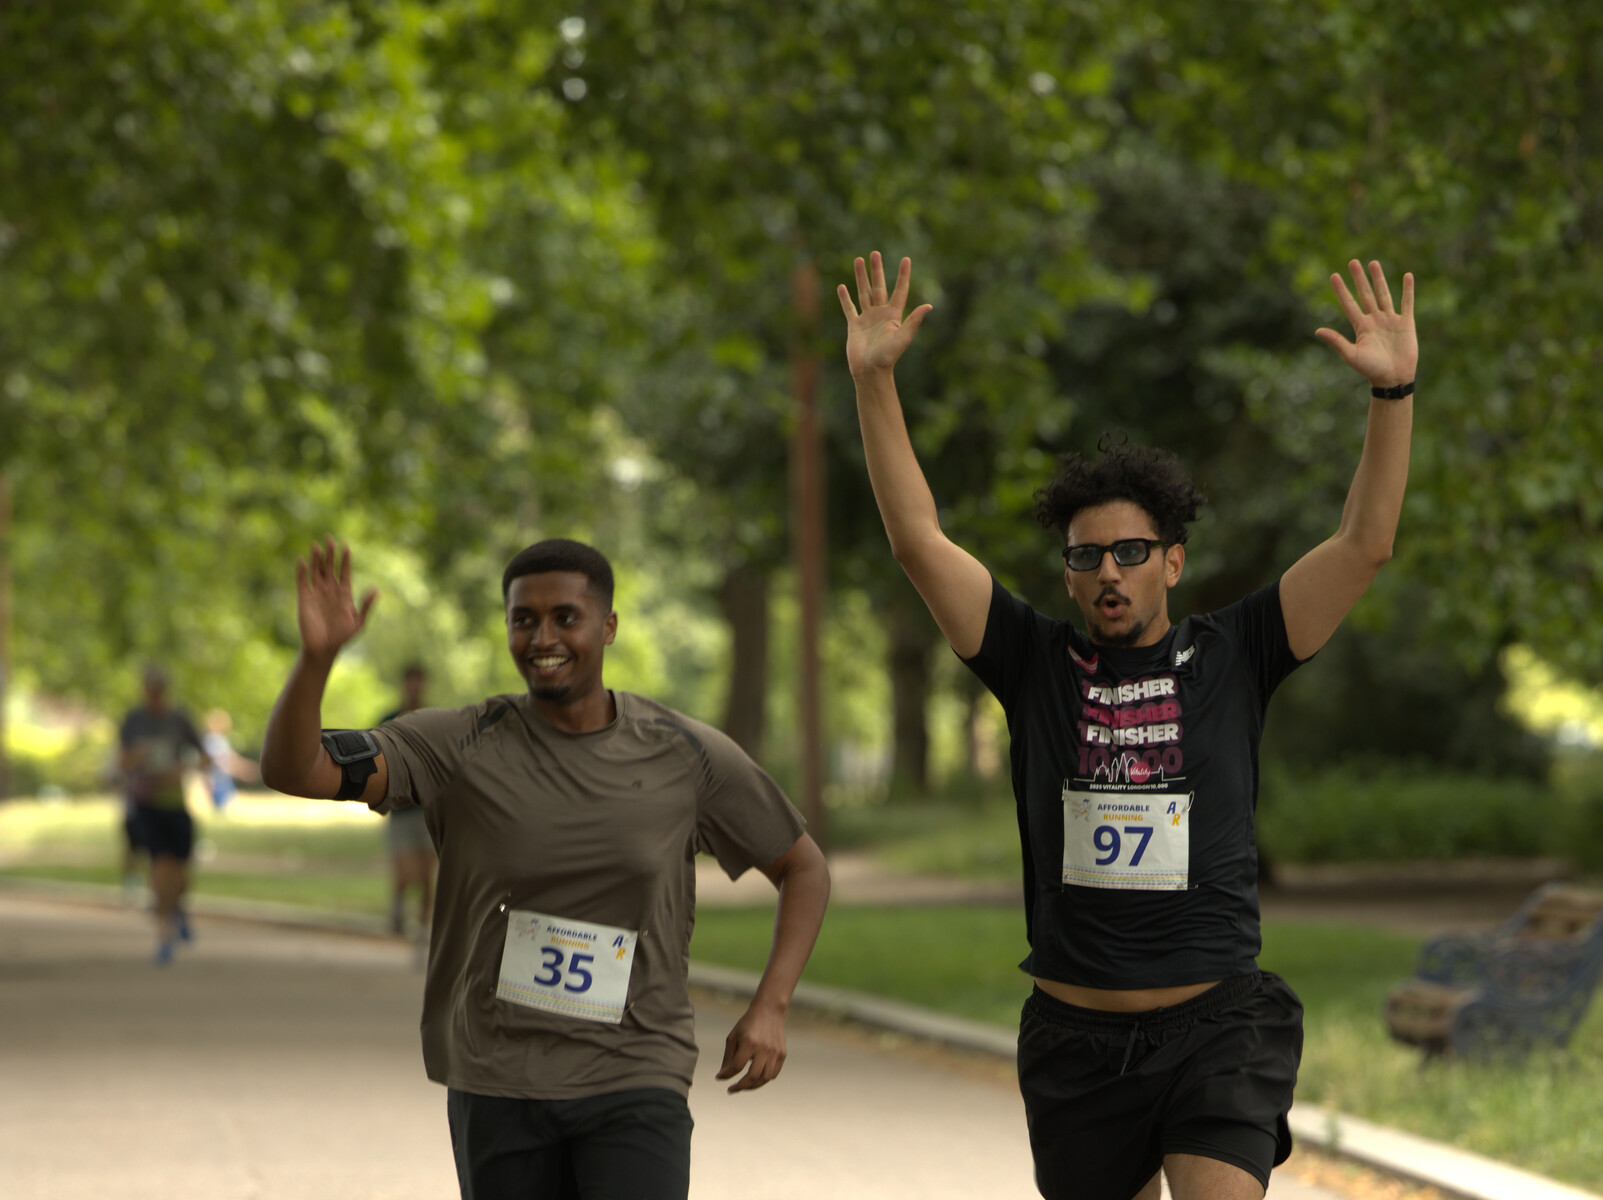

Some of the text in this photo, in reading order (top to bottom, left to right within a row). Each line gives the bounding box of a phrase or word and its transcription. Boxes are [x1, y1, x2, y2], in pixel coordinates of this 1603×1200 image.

[1088, 678, 1175, 705] FINISHER
[1087, 703, 1178, 728] FINISHER
[1086, 723, 1179, 746] FINISHER
[1097, 803, 1150, 812] AFFORDABLE
[1166, 801, 1177, 814] A
[1103, 814, 1144, 822] RUNNING
[1093, 825, 1154, 867] 97
[546, 925, 599, 942] AFFORDABLE
[550, 936, 590, 950] RUNNING
[533, 946, 595, 993] 35
